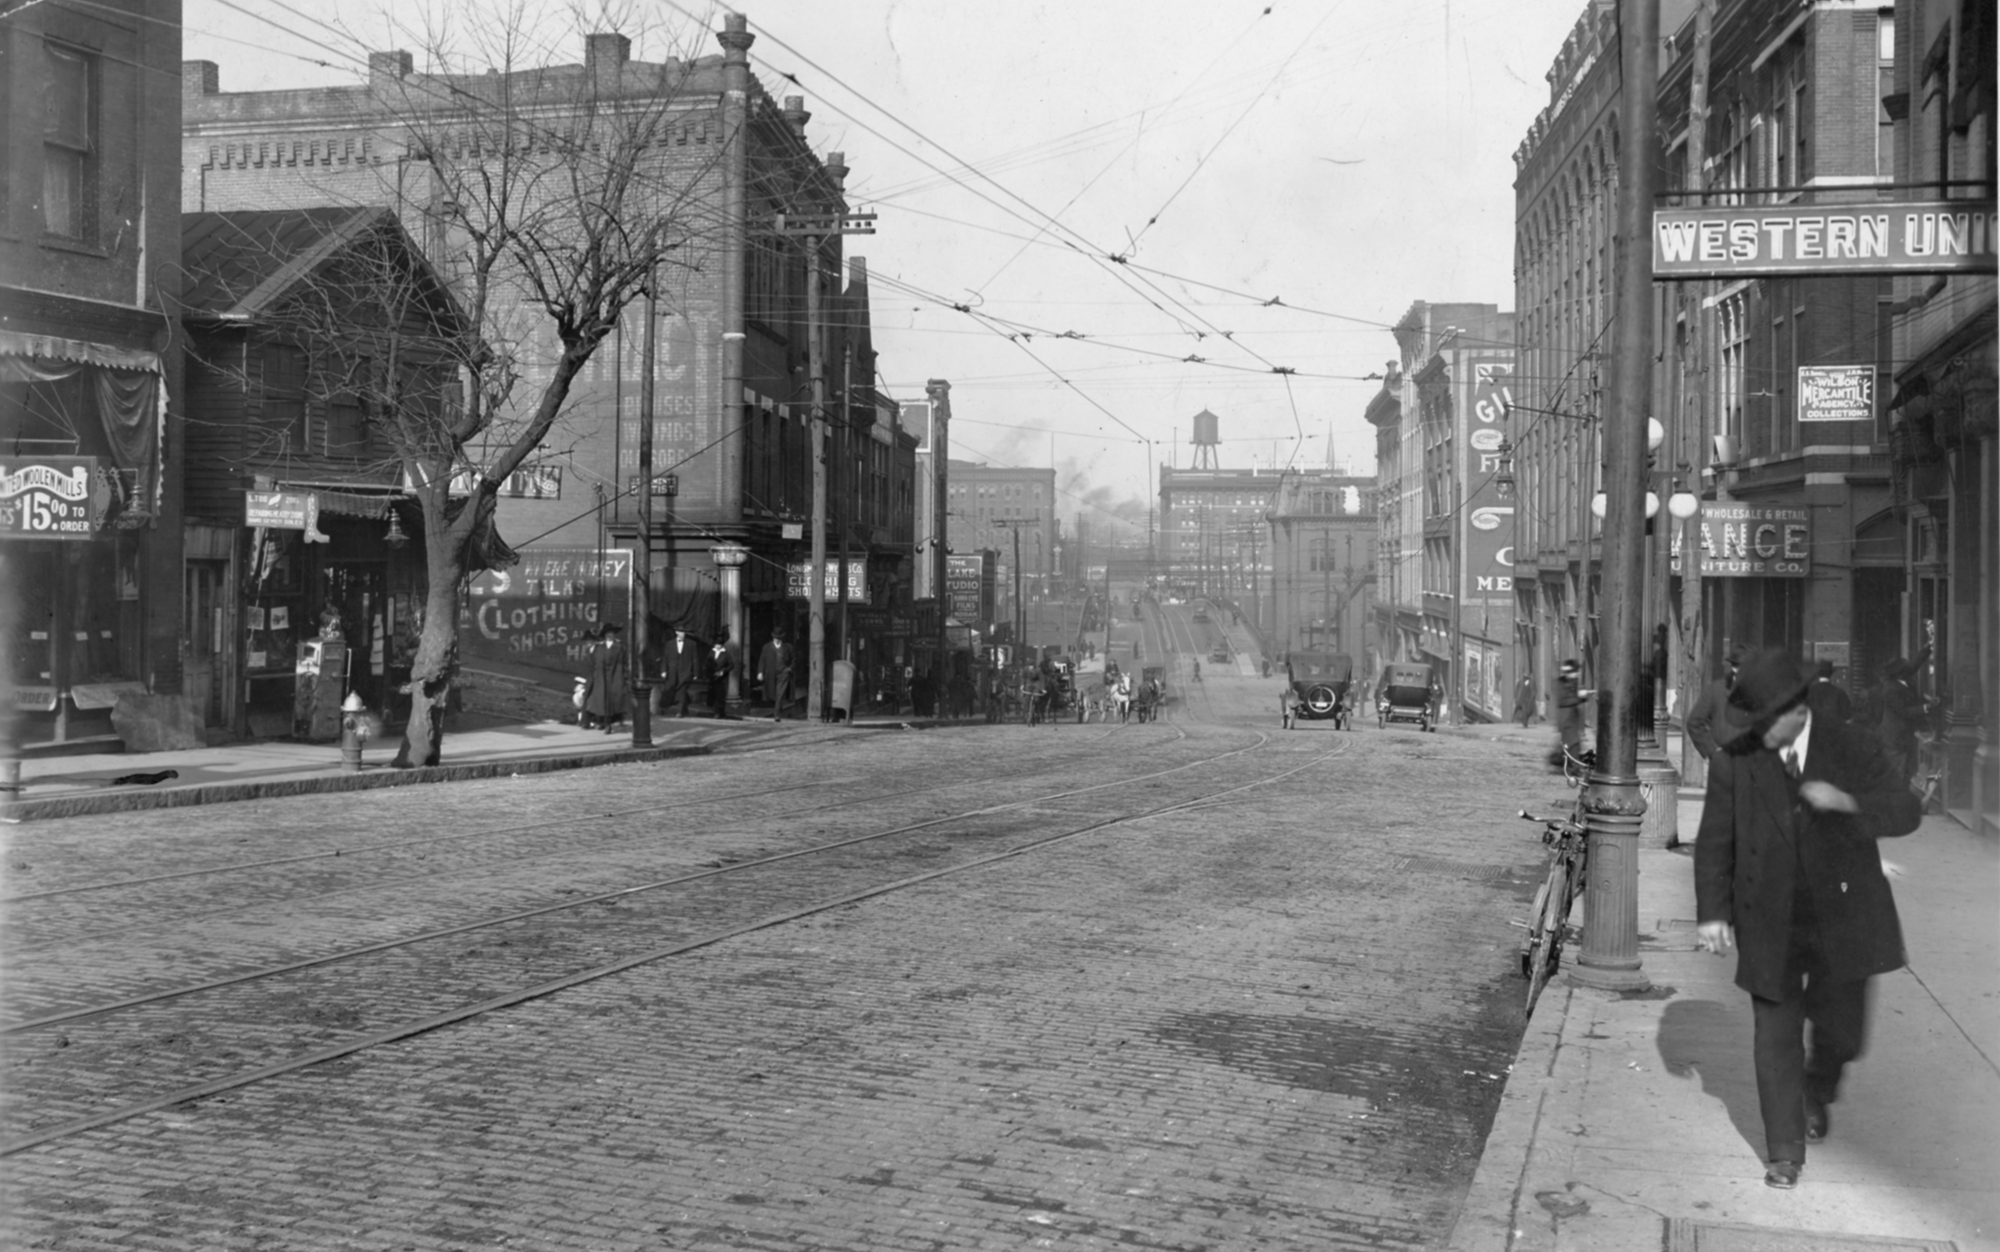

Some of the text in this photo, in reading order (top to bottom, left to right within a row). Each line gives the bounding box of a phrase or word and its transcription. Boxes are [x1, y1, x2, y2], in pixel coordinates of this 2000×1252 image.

[1659, 213, 1998, 263] WESTERN UNI
[1803, 382, 1871, 406] MERCANTILE
[56, 475, 84, 496] MILLS
[631, 485, 675, 494] DTIST
[73, 507, 86, 517] TO
[1706, 509, 1763, 520] WHOLESALE
[1764, 510, 1773, 520] &
[1775, 510, 1807, 520] RETAIL
[60, 521, 90, 531] ORDER
[525, 560, 571, 576] WHERE
[1773, 562, 1803, 572] CO.
[947, 569, 975, 578] LAKE
[789, 577, 857, 586] CLOHIG
[947, 581, 979, 590] TUDIO
[509, 626, 568, 653] SHOES
